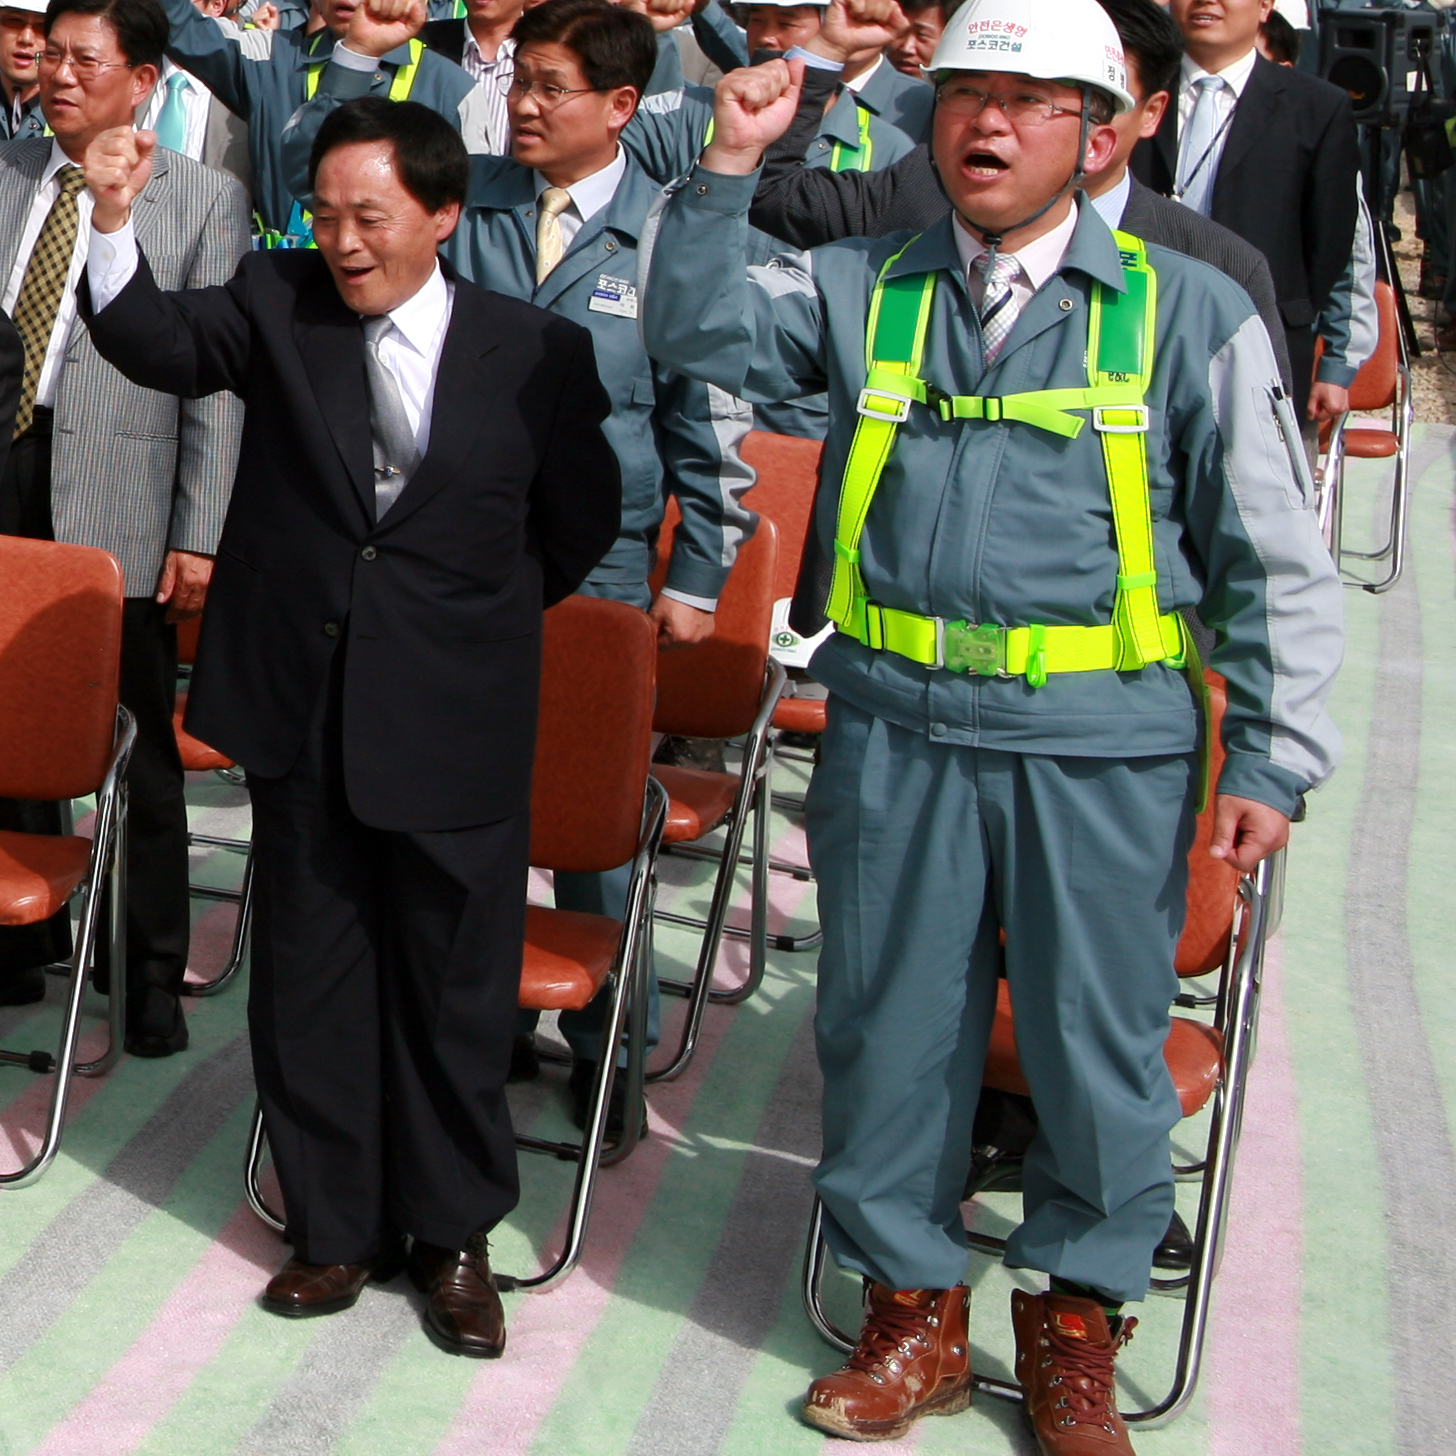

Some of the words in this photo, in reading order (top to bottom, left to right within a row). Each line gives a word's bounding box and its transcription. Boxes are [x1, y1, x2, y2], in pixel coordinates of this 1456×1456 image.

[968, 19, 1028, 38] 안전은생명
[966, 40, 1022, 53] 포스코건설
[597, 278, 636, 297] 포스코
